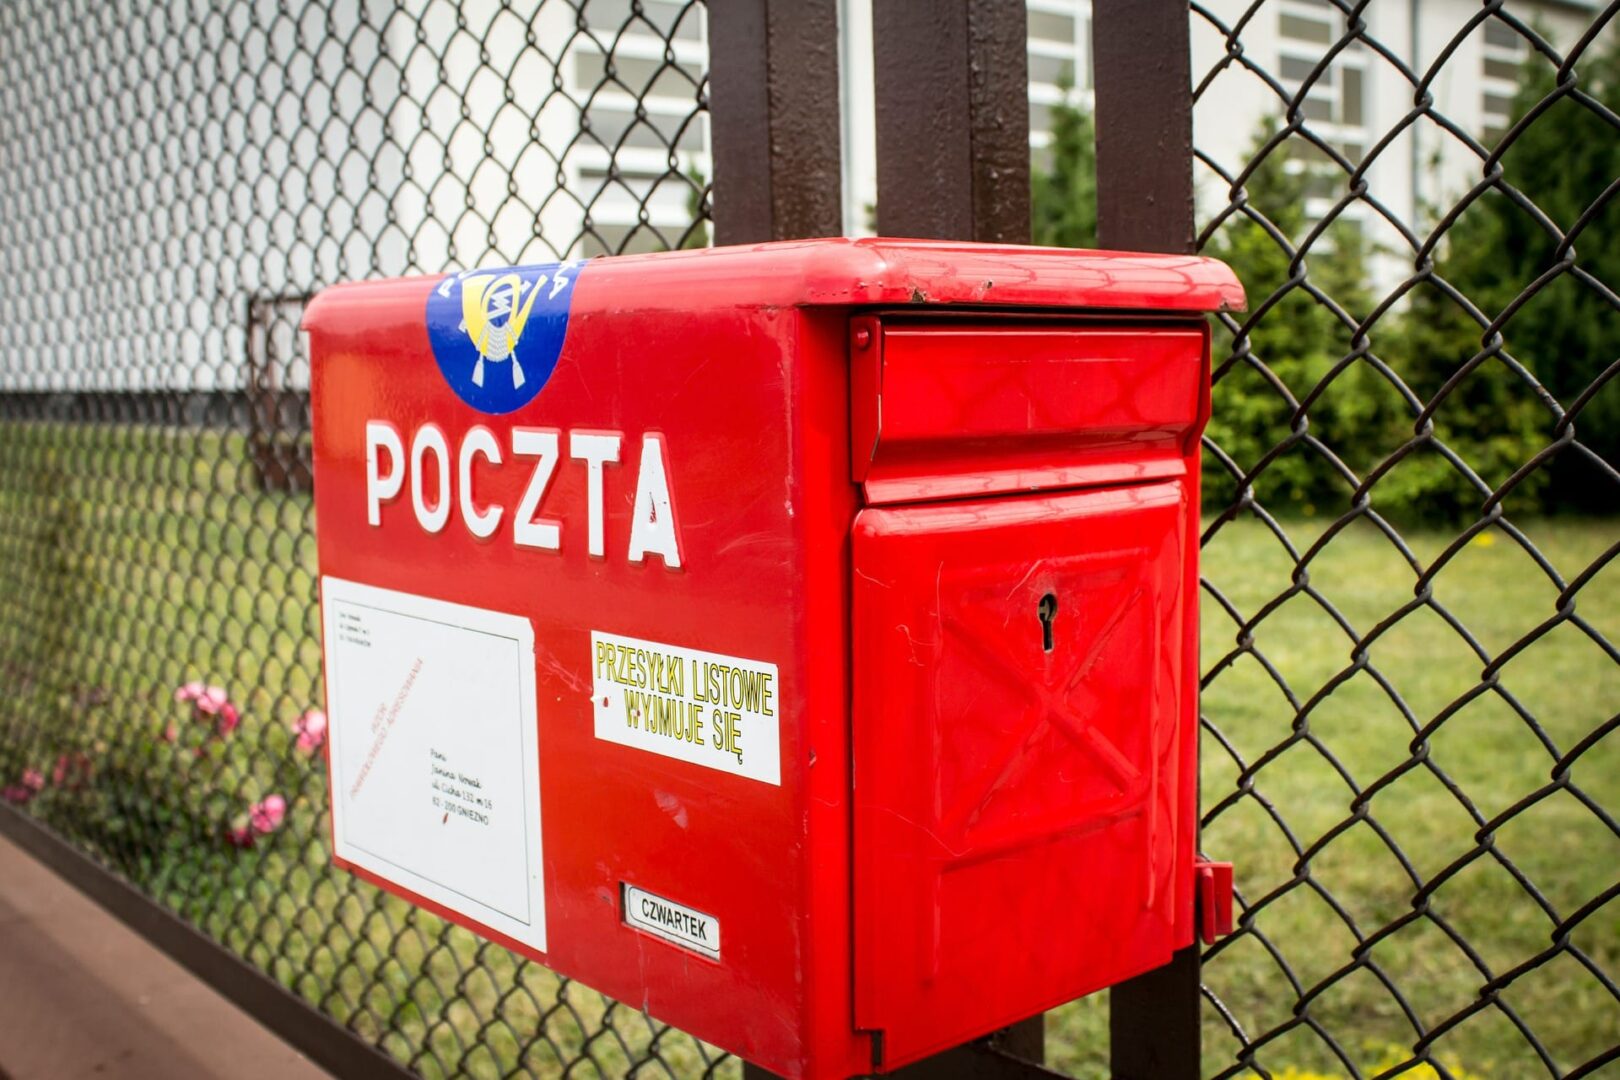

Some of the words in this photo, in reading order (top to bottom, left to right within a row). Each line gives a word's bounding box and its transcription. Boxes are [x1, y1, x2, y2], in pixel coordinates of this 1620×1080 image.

[366, 419, 681, 568] POCZTA
[596, 640, 684, 697] PRZESYŁKI
[692, 660, 774, 716] LISTOWE
[624, 688, 705, 745] WYJMUJE
[712, 709, 743, 765] SIĘ
[641, 898, 707, 941] CZWARTEK
